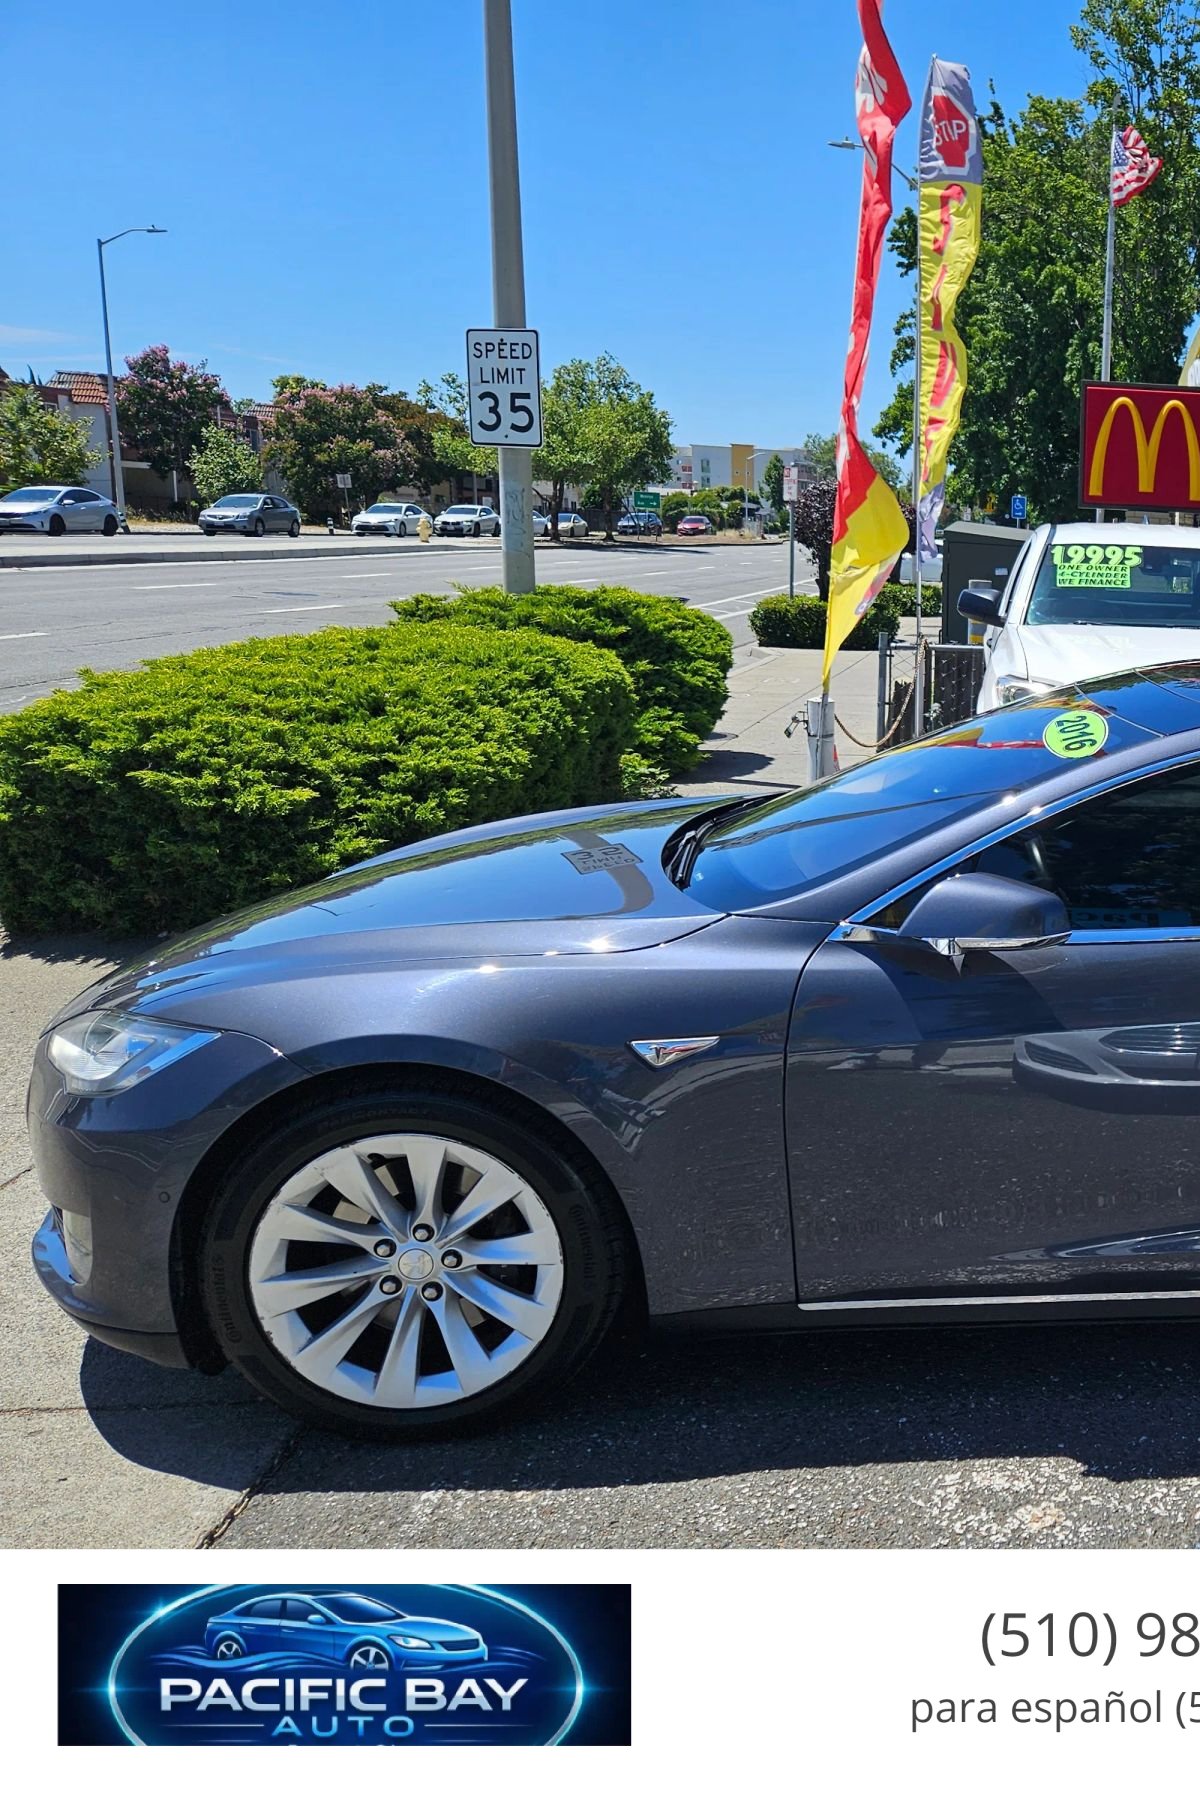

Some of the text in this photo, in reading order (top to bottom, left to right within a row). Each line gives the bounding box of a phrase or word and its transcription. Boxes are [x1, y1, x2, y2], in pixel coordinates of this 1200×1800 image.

[473, 342, 533, 360] SPEED
[480, 367, 526, 384] LIMIT
[478, 391, 534, 433] 35
[1051, 545, 1143, 568] 19995
[1086, 564, 1129, 572] OWNER
[1056, 715, 1098, 752] 2016
